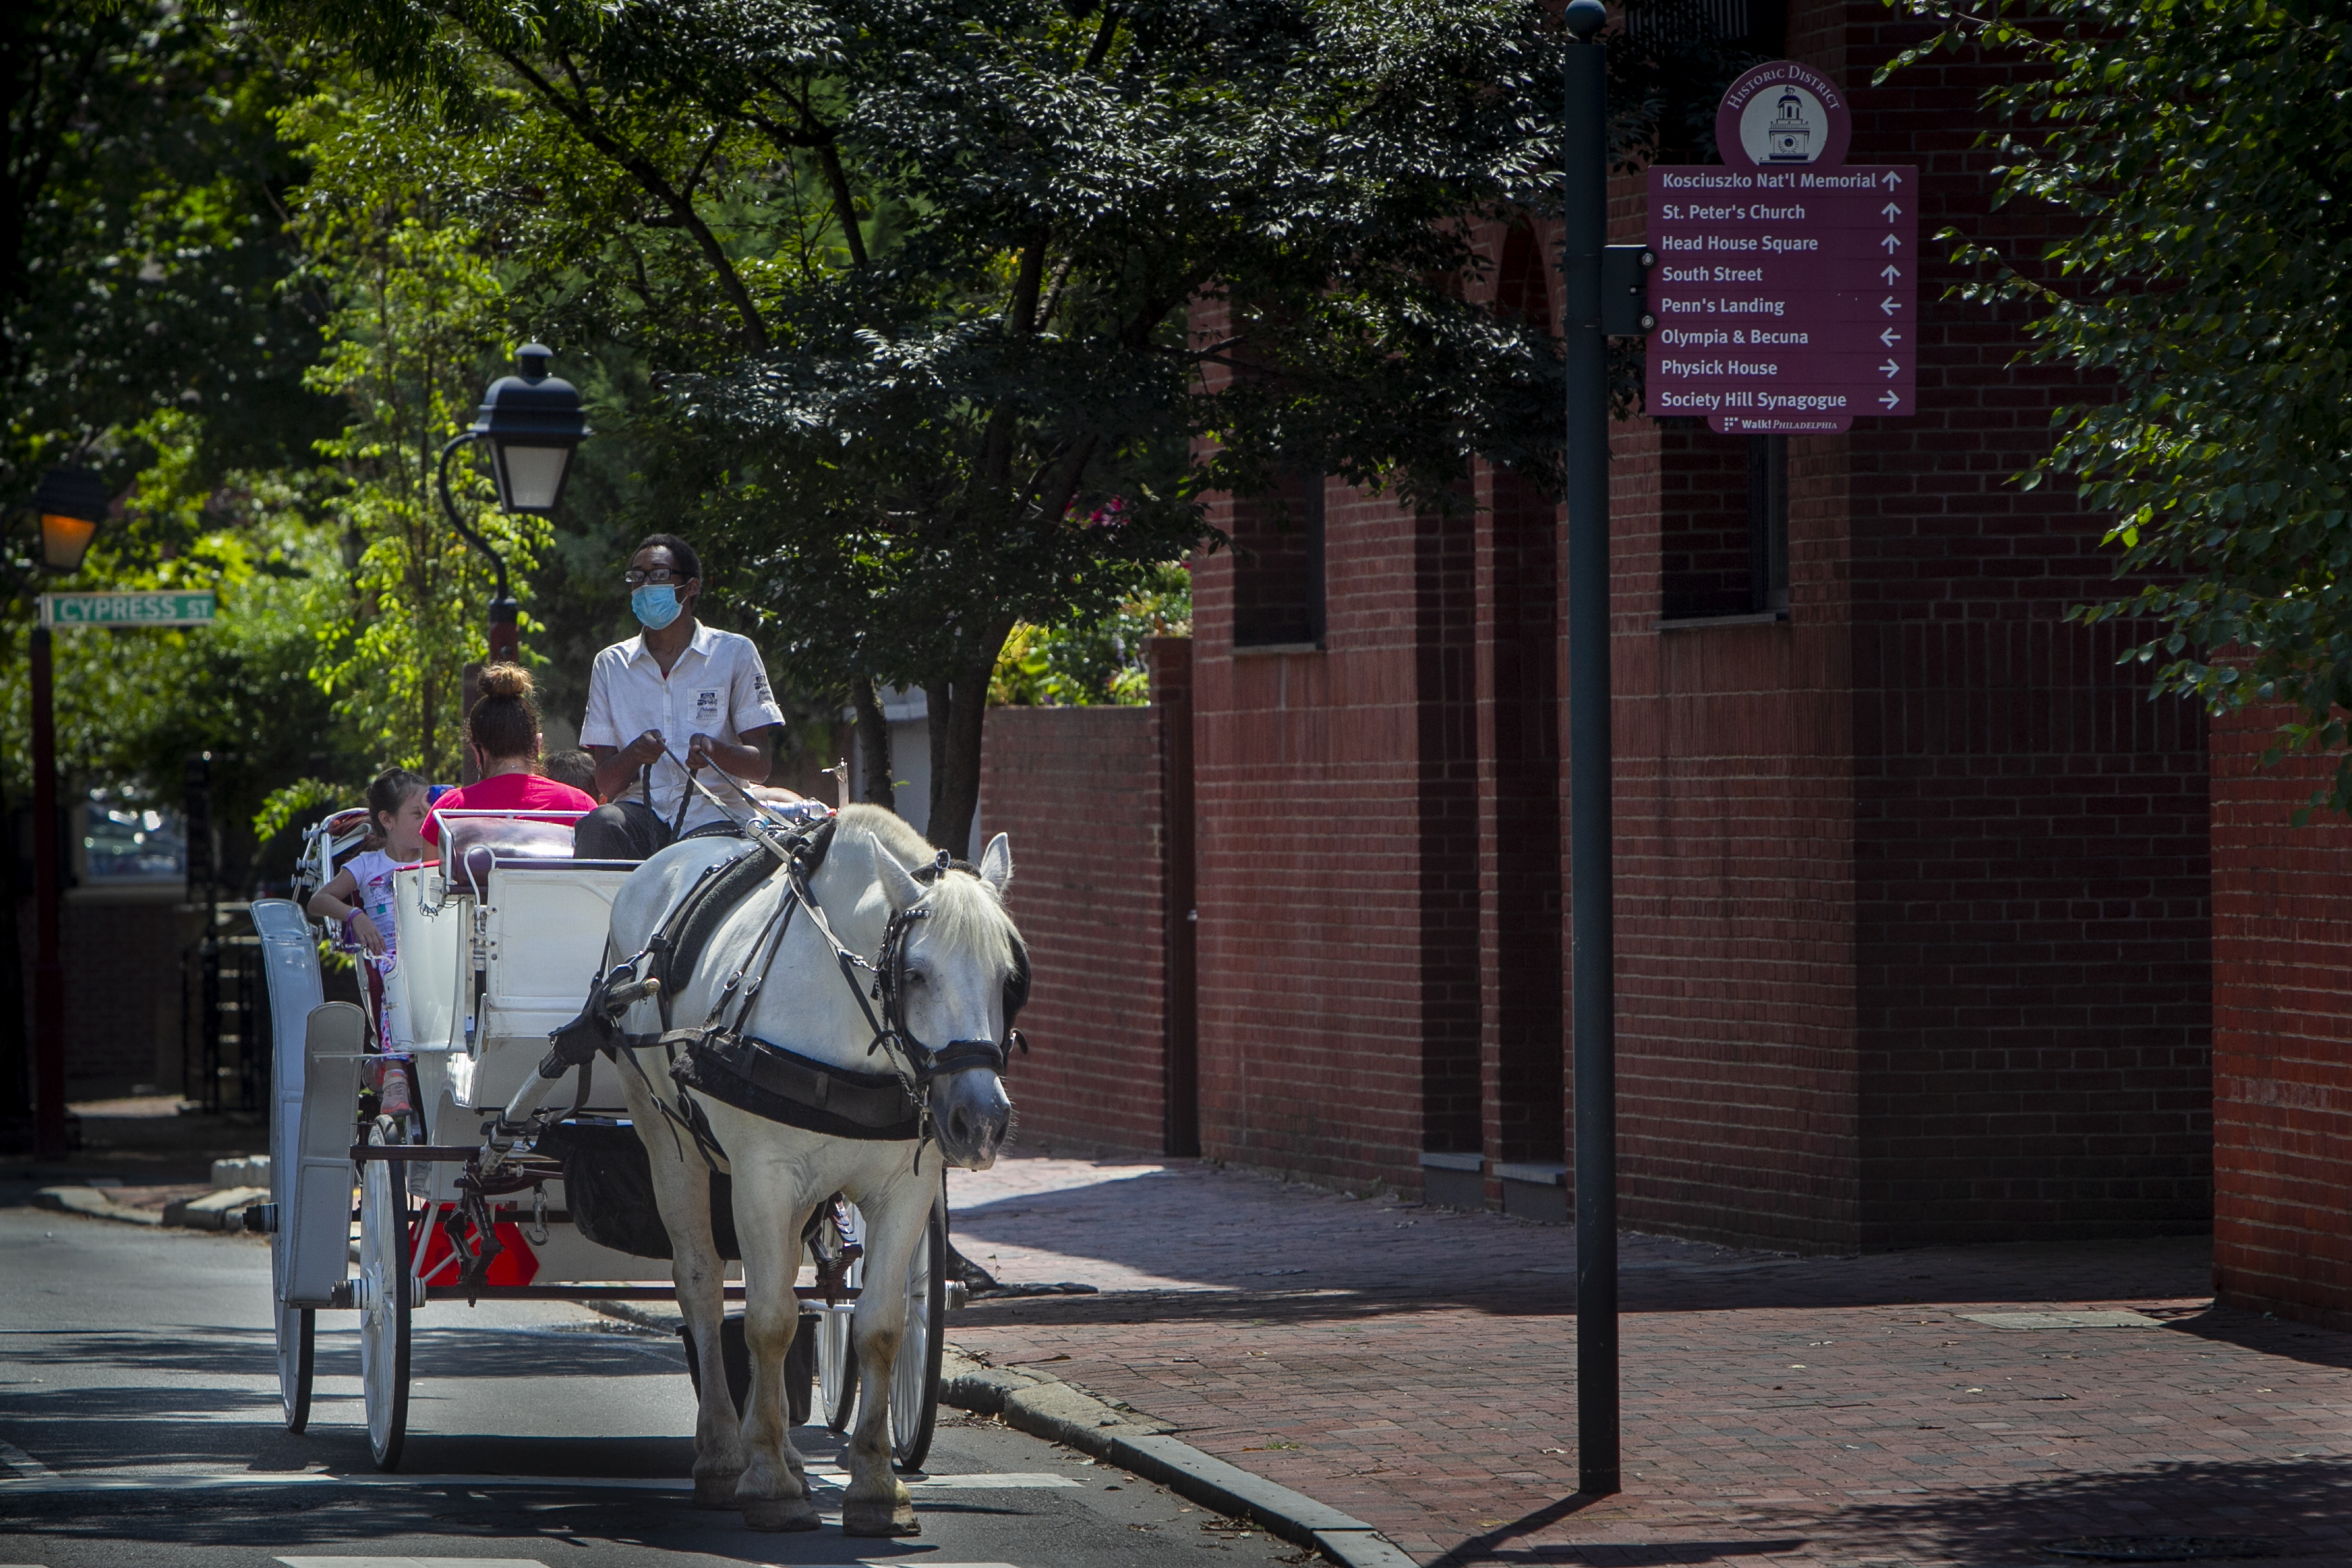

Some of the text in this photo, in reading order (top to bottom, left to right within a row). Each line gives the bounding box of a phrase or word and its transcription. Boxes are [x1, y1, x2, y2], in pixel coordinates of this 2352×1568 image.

[1663, 173, 1876, 188] Kosciuszko Nat'l Memorial
[1662, 204, 1805, 220] St. Peter's Church
[1662, 235, 1819, 253] Head House Square
[1662, 266, 1763, 282] South Street
[1661, 297, 1785, 315] Penn's Landing
[1661, 329, 1809, 347] Olympia & Becuna
[1661, 359, 1778, 378] Physick House
[1660, 391, 1847, 411] Society Hill Synagogue
[1741, 419, 1772, 429] Walk!
[61, 596, 211, 620] CYPRESS ST
